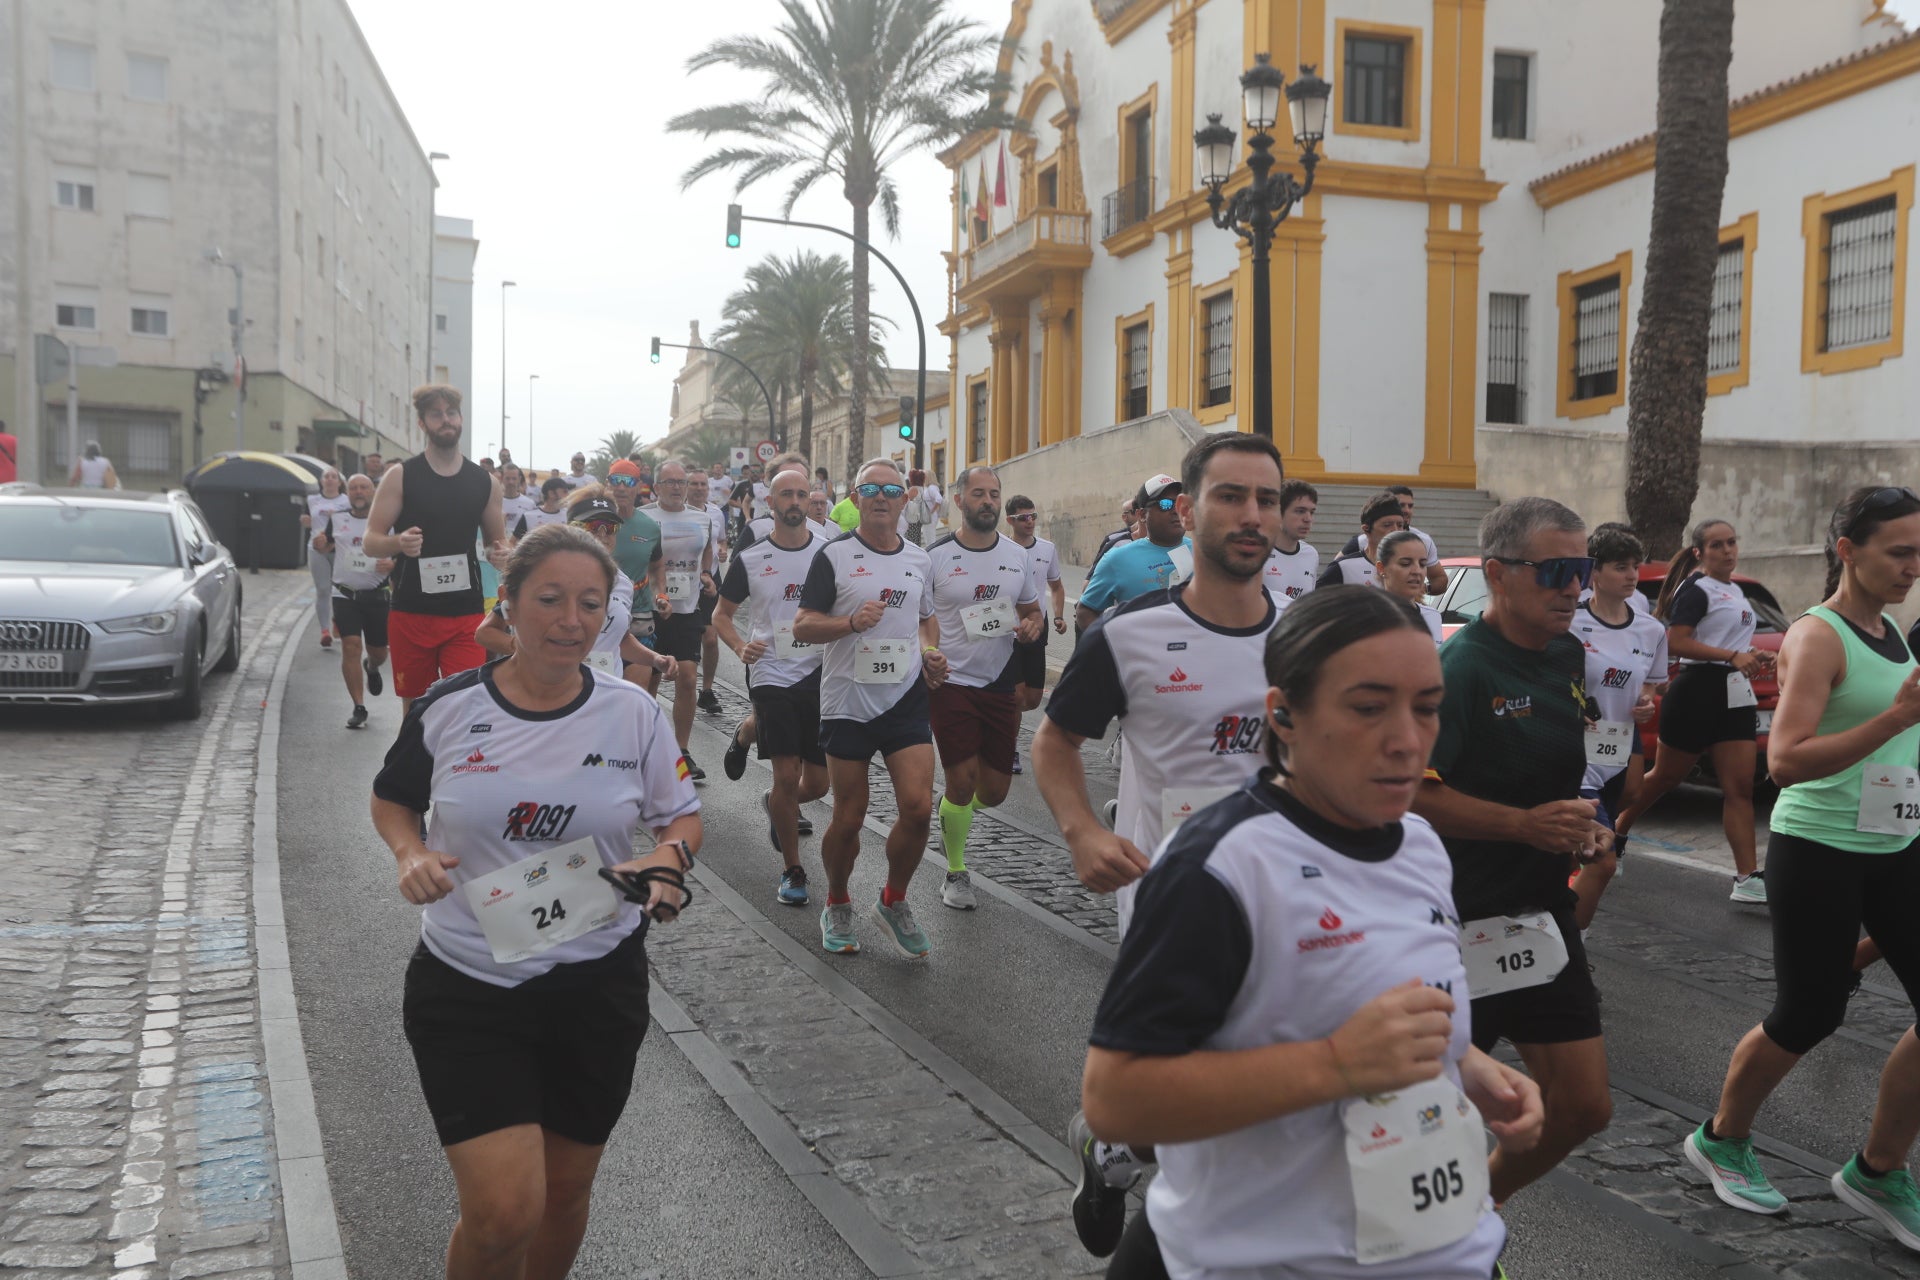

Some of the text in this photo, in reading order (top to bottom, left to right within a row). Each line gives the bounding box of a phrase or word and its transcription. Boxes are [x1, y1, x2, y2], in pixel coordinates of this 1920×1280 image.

[760, 447, 774, 456] 30
[436, 574, 456, 585] 527
[981, 619, 1001, 633] 452
[0, 654, 59, 670] 73 KGD
[872, 662, 895, 673] 391
[1155, 683, 1203, 694] Santander
[1596, 743, 1618, 755] 205
[452, 764, 500, 774] Santander
[608, 759, 638, 770] mupol
[1893, 803, 1920, 820] 128
[531, 898, 566, 930] 24
[1297, 930, 1366, 953] Santander
[1496, 949, 1535, 973] 103
[1411, 1158, 1464, 1212] 505
